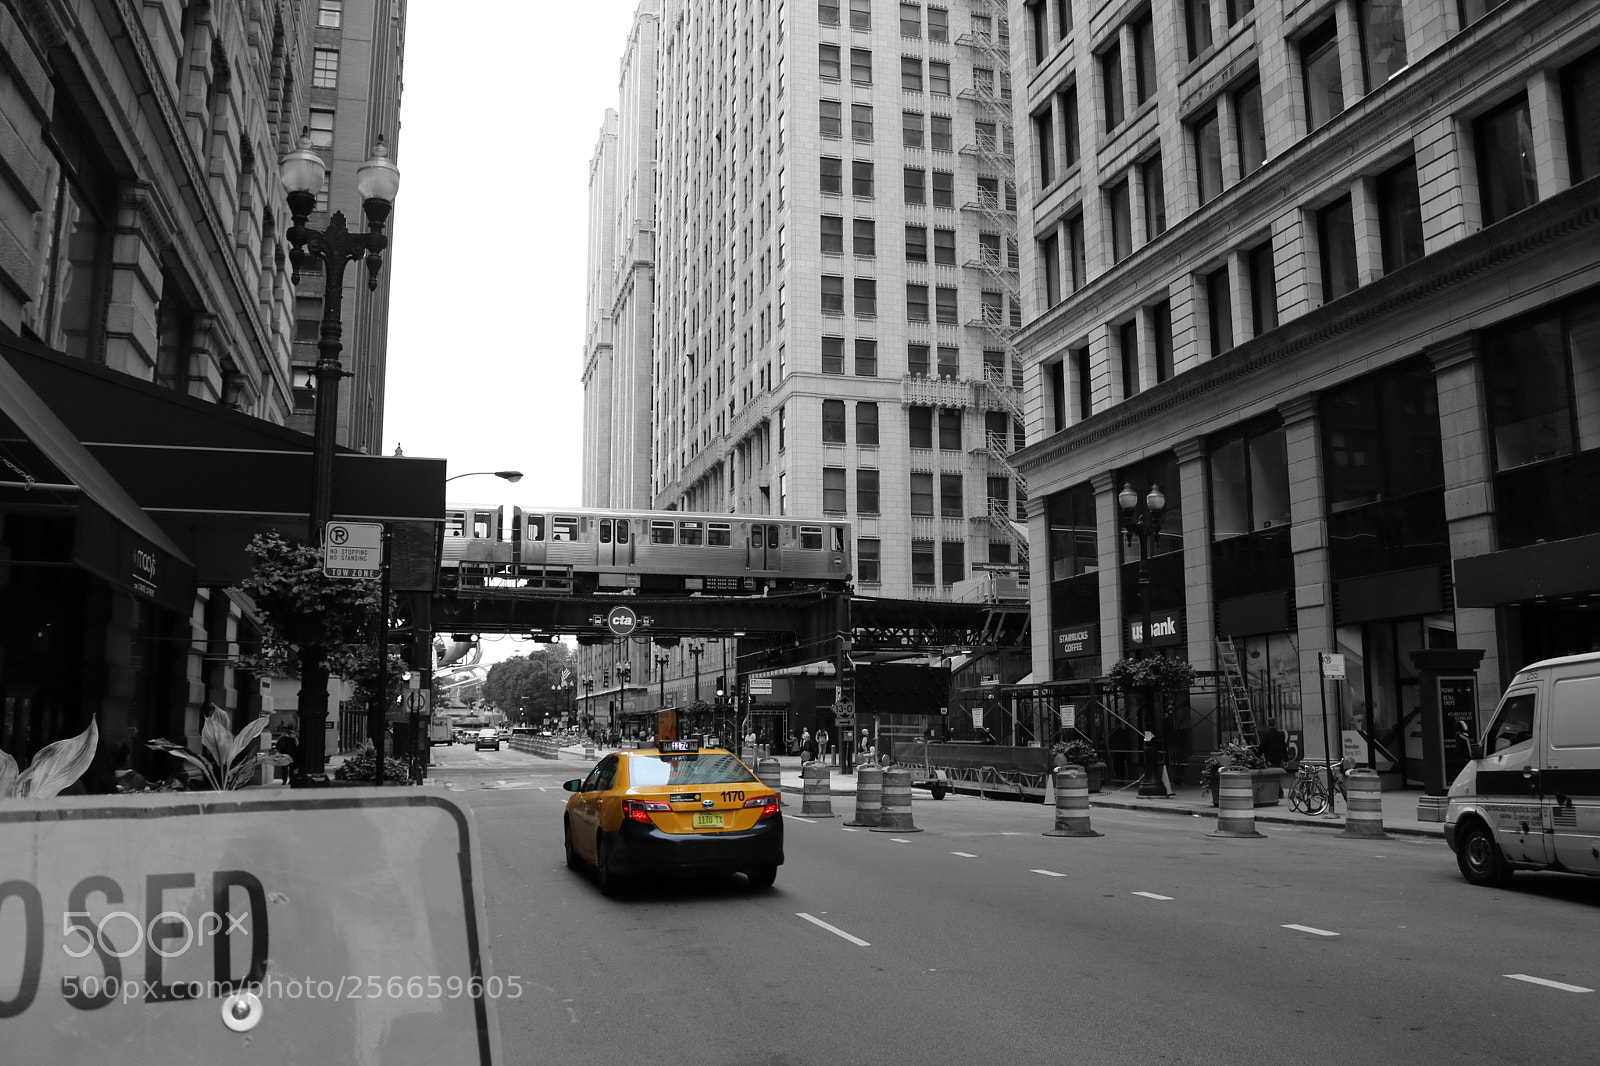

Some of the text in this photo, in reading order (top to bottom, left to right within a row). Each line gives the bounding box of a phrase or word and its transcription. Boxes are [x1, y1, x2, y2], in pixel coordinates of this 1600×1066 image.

[352, 569, 374, 577] ZONE
[612, 615, 633, 625] cta
[1059, 630, 1089, 643] STARBUCKS
[1064, 642, 1083, 653] COFFEE
[720, 790, 745, 802] 1170
[698, 816, 723, 824] 1170 TX
